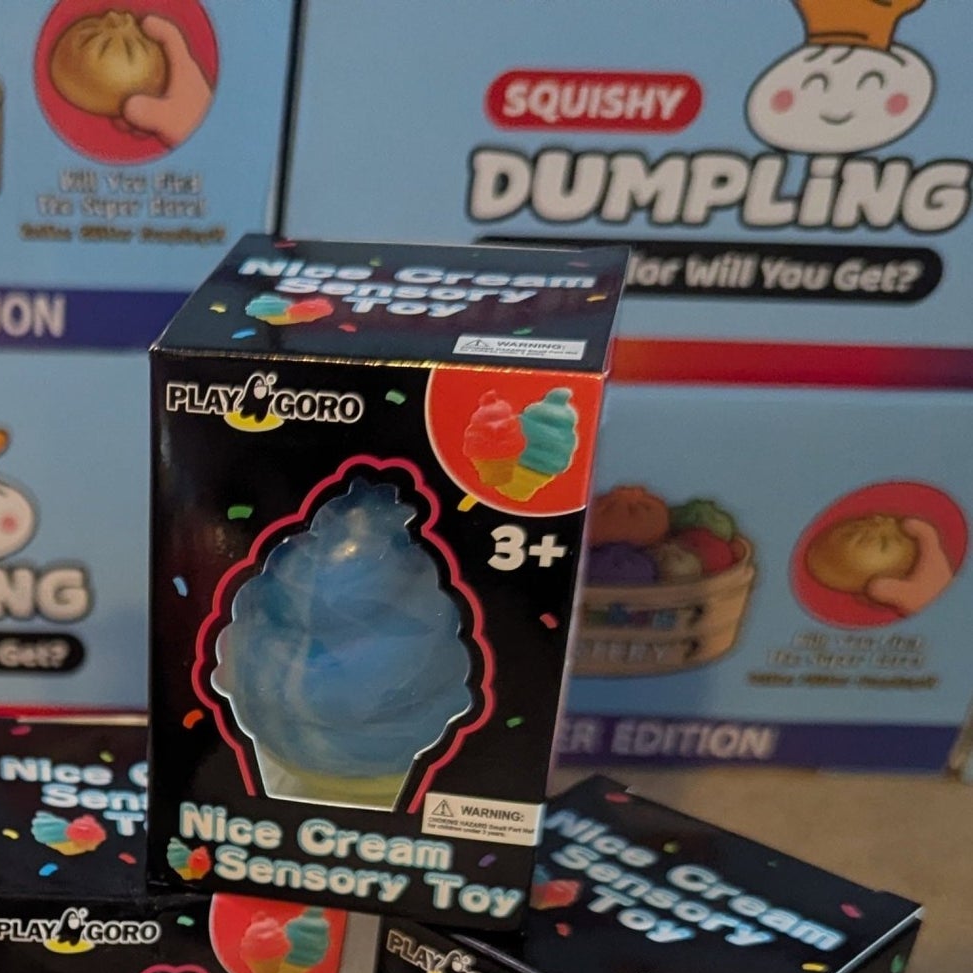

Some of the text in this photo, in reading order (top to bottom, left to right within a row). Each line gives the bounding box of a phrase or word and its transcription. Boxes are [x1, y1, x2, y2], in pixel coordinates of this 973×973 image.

[502, 80, 688, 124] SQUISHY
[238, 257, 598, 289] Nice Cream
[275, 277, 537, 304] Sensory
[629, 251, 920, 294] lor Will You Get?
[342, 296, 468, 318] Toy
[165, 381, 365, 423] PLAY GORO
[487, 525, 567, 570] 3+
[611, 719, 778, 761] EDITION
[0, 755, 113, 786] Nice
[41, 783, 148, 812] Sen
[461, 805, 525, 822] WARNING:
[180, 801, 454, 870] Nice Cream
[214, 845, 523, 918] Sensory Toy
[543, 808, 847, 951] Nice Cream
[550, 843, 776, 946] Sensory
[85, 921, 162, 944] GORO
[587, 884, 696, 943] Toy
[387, 929, 442, 972] PLAY
